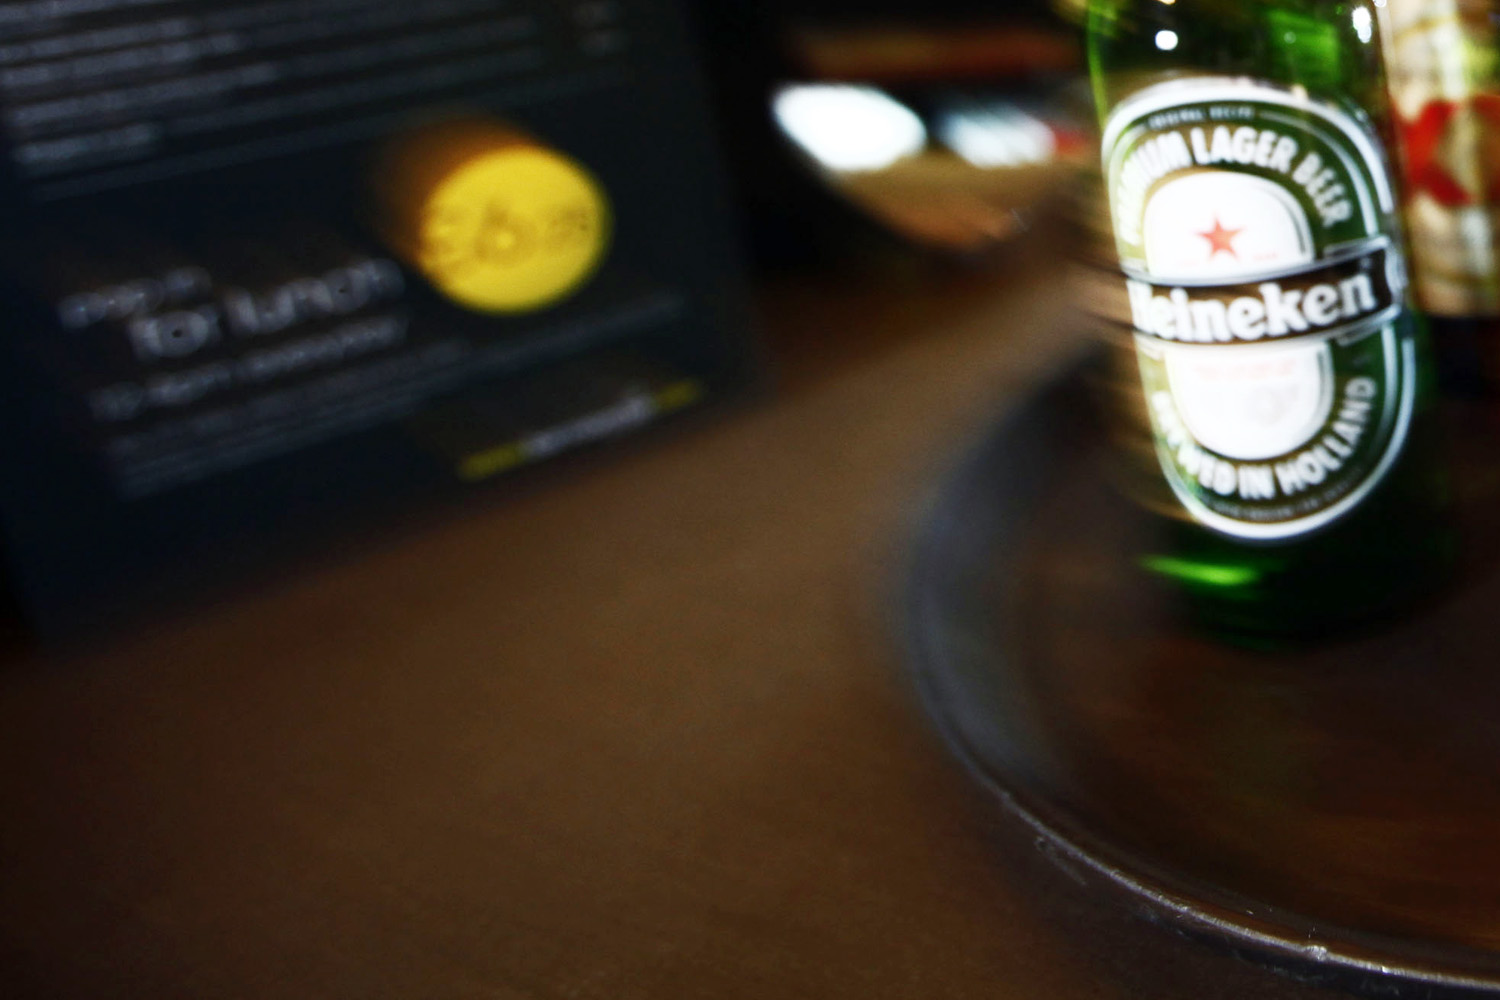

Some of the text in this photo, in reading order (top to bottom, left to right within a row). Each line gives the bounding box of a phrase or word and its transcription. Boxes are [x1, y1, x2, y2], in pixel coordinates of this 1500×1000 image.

[1190, 125, 1299, 174] LAGER
[1292, 151, 1352, 228] BEER
[1238, 463, 1277, 500] IN
[1275, 376, 1377, 497] HOLLAND
